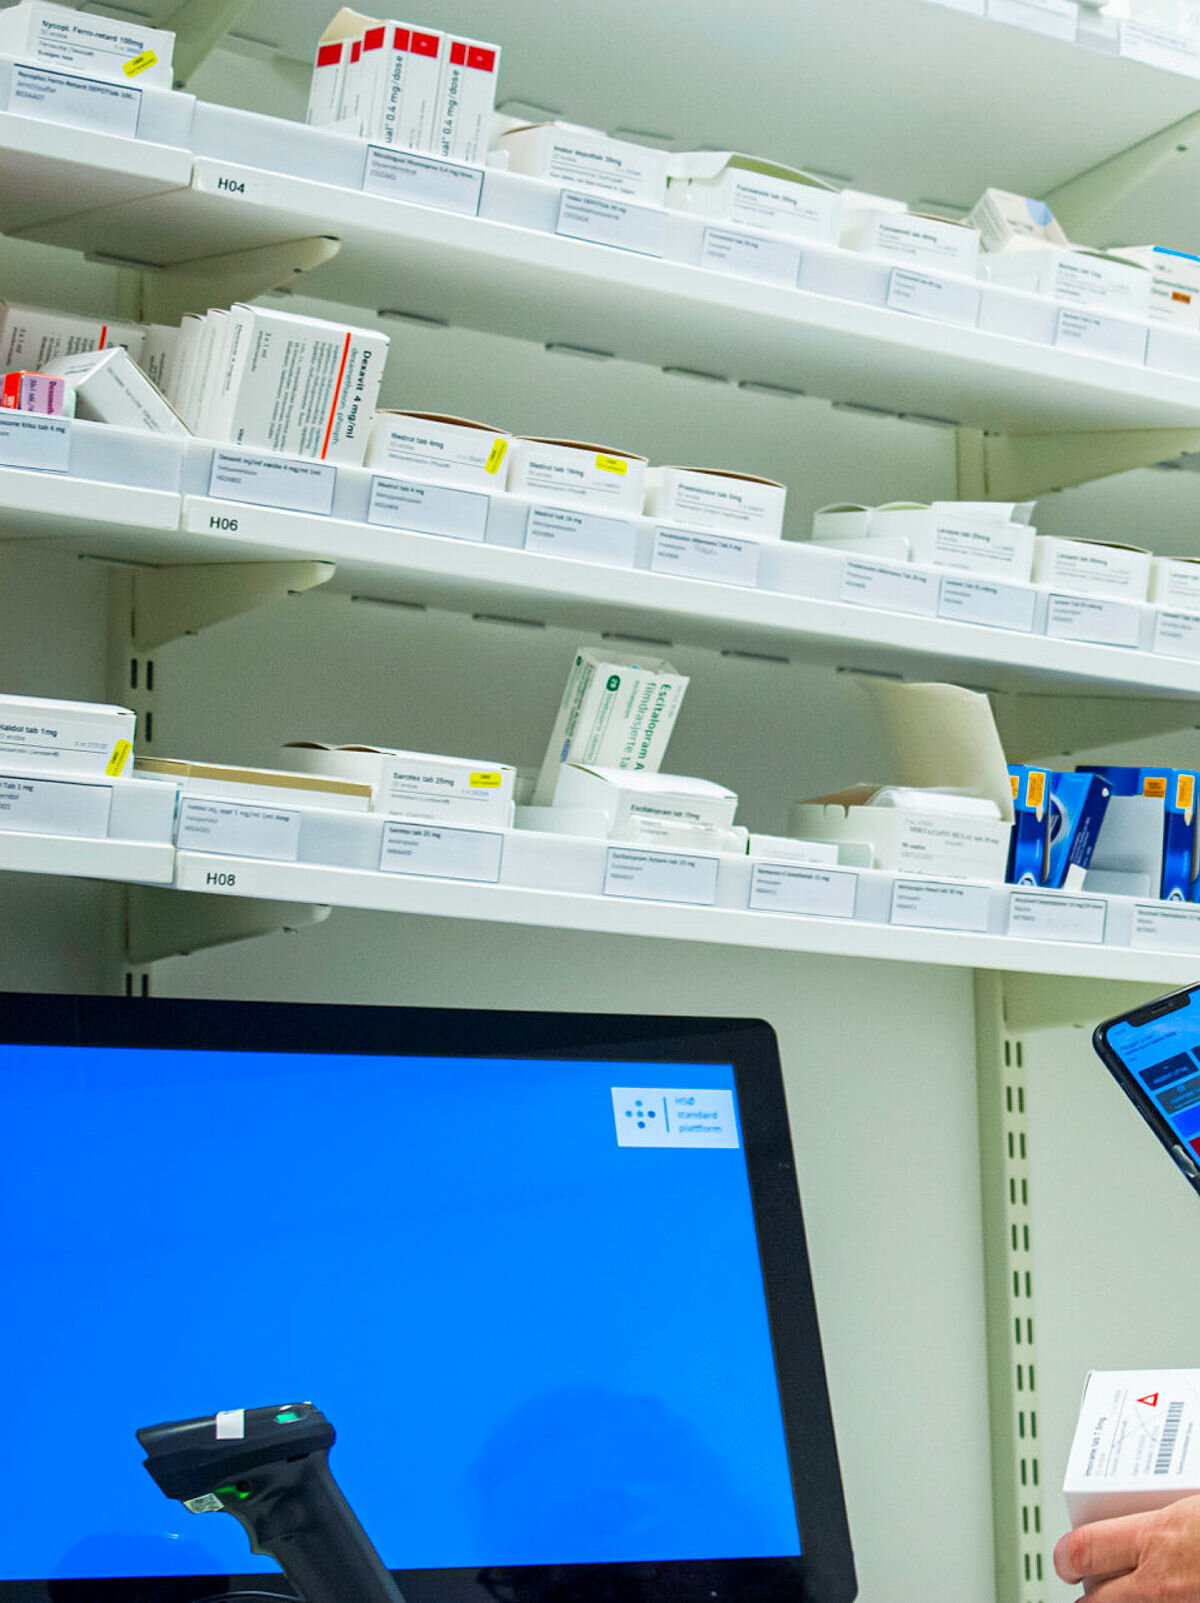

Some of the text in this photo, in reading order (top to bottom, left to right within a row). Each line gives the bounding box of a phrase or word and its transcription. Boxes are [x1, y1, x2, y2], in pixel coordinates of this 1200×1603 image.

[390, 55, 403, 104] mg/dose
[447, 69, 460, 118] mg/dose
[217, 177, 246, 195] H04
[355, 349, 373, 391] Dexavit
[56, 426, 66, 435] mg
[345, 404, 359, 440] mg/ml
[209, 515, 239, 533] H06
[633, 684, 673, 771] Escitalopram A
[206, 872, 237, 887] H08
